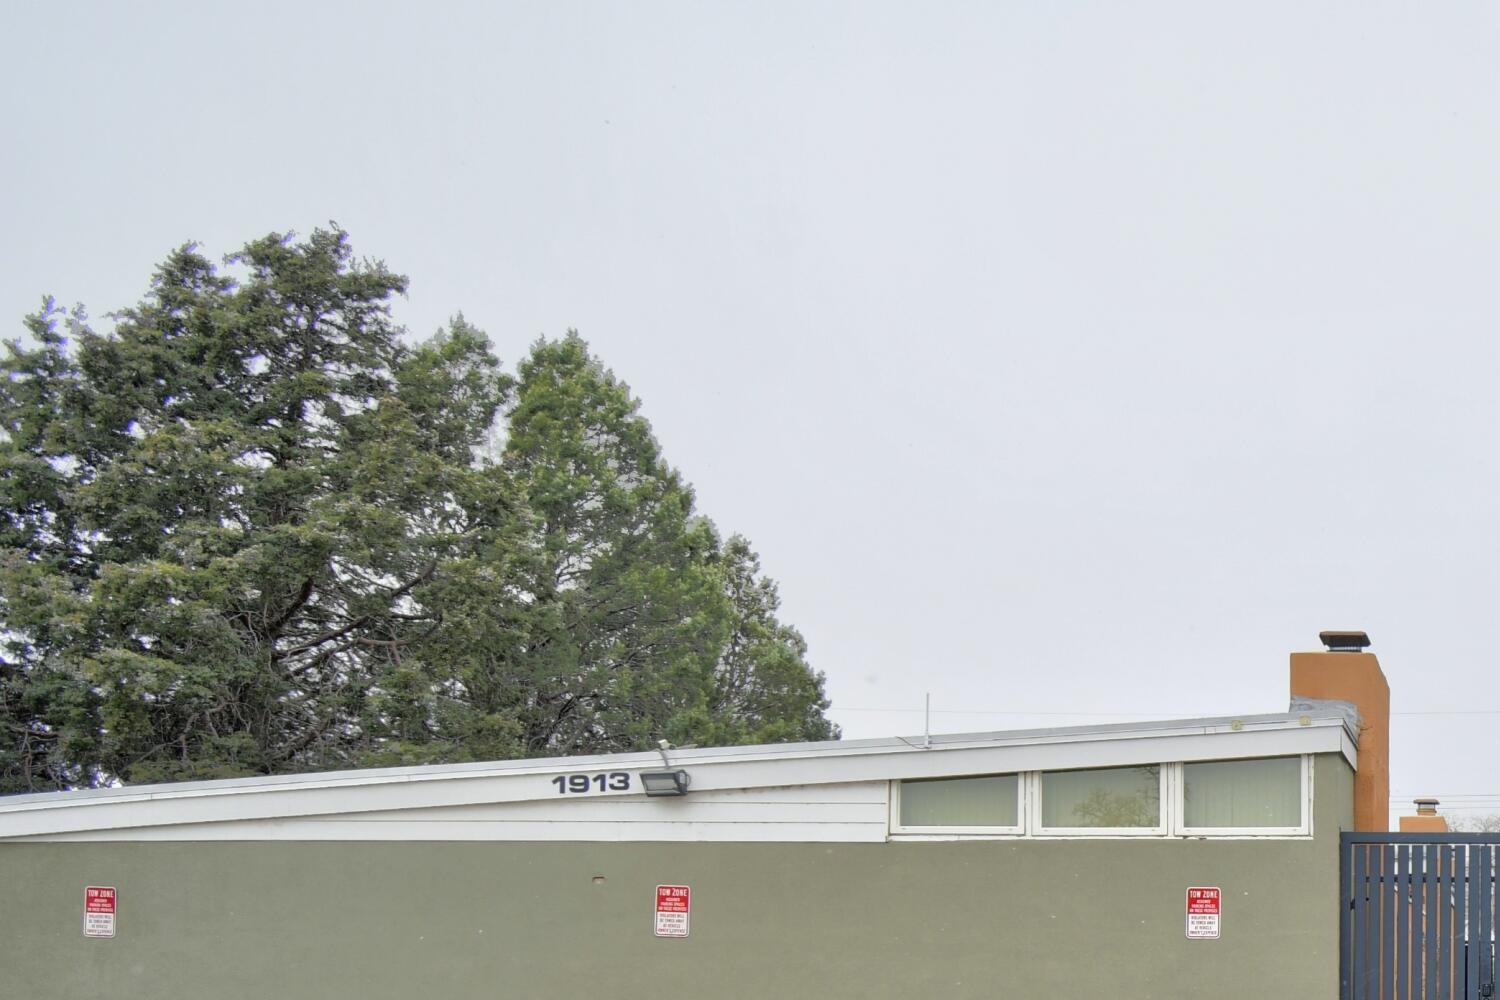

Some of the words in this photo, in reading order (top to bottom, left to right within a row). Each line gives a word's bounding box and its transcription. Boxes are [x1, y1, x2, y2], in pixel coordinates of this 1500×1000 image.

[552, 772, 630, 794] 1913
[88, 889, 99, 897] TOW
[100, 890, 114, 898] ZONE
[659, 888, 671, 896] TOW
[672, 888, 688, 896] ZONE
[1190, 890, 1201, 898] TOW
[1202, 890, 1218, 898] ZONE
